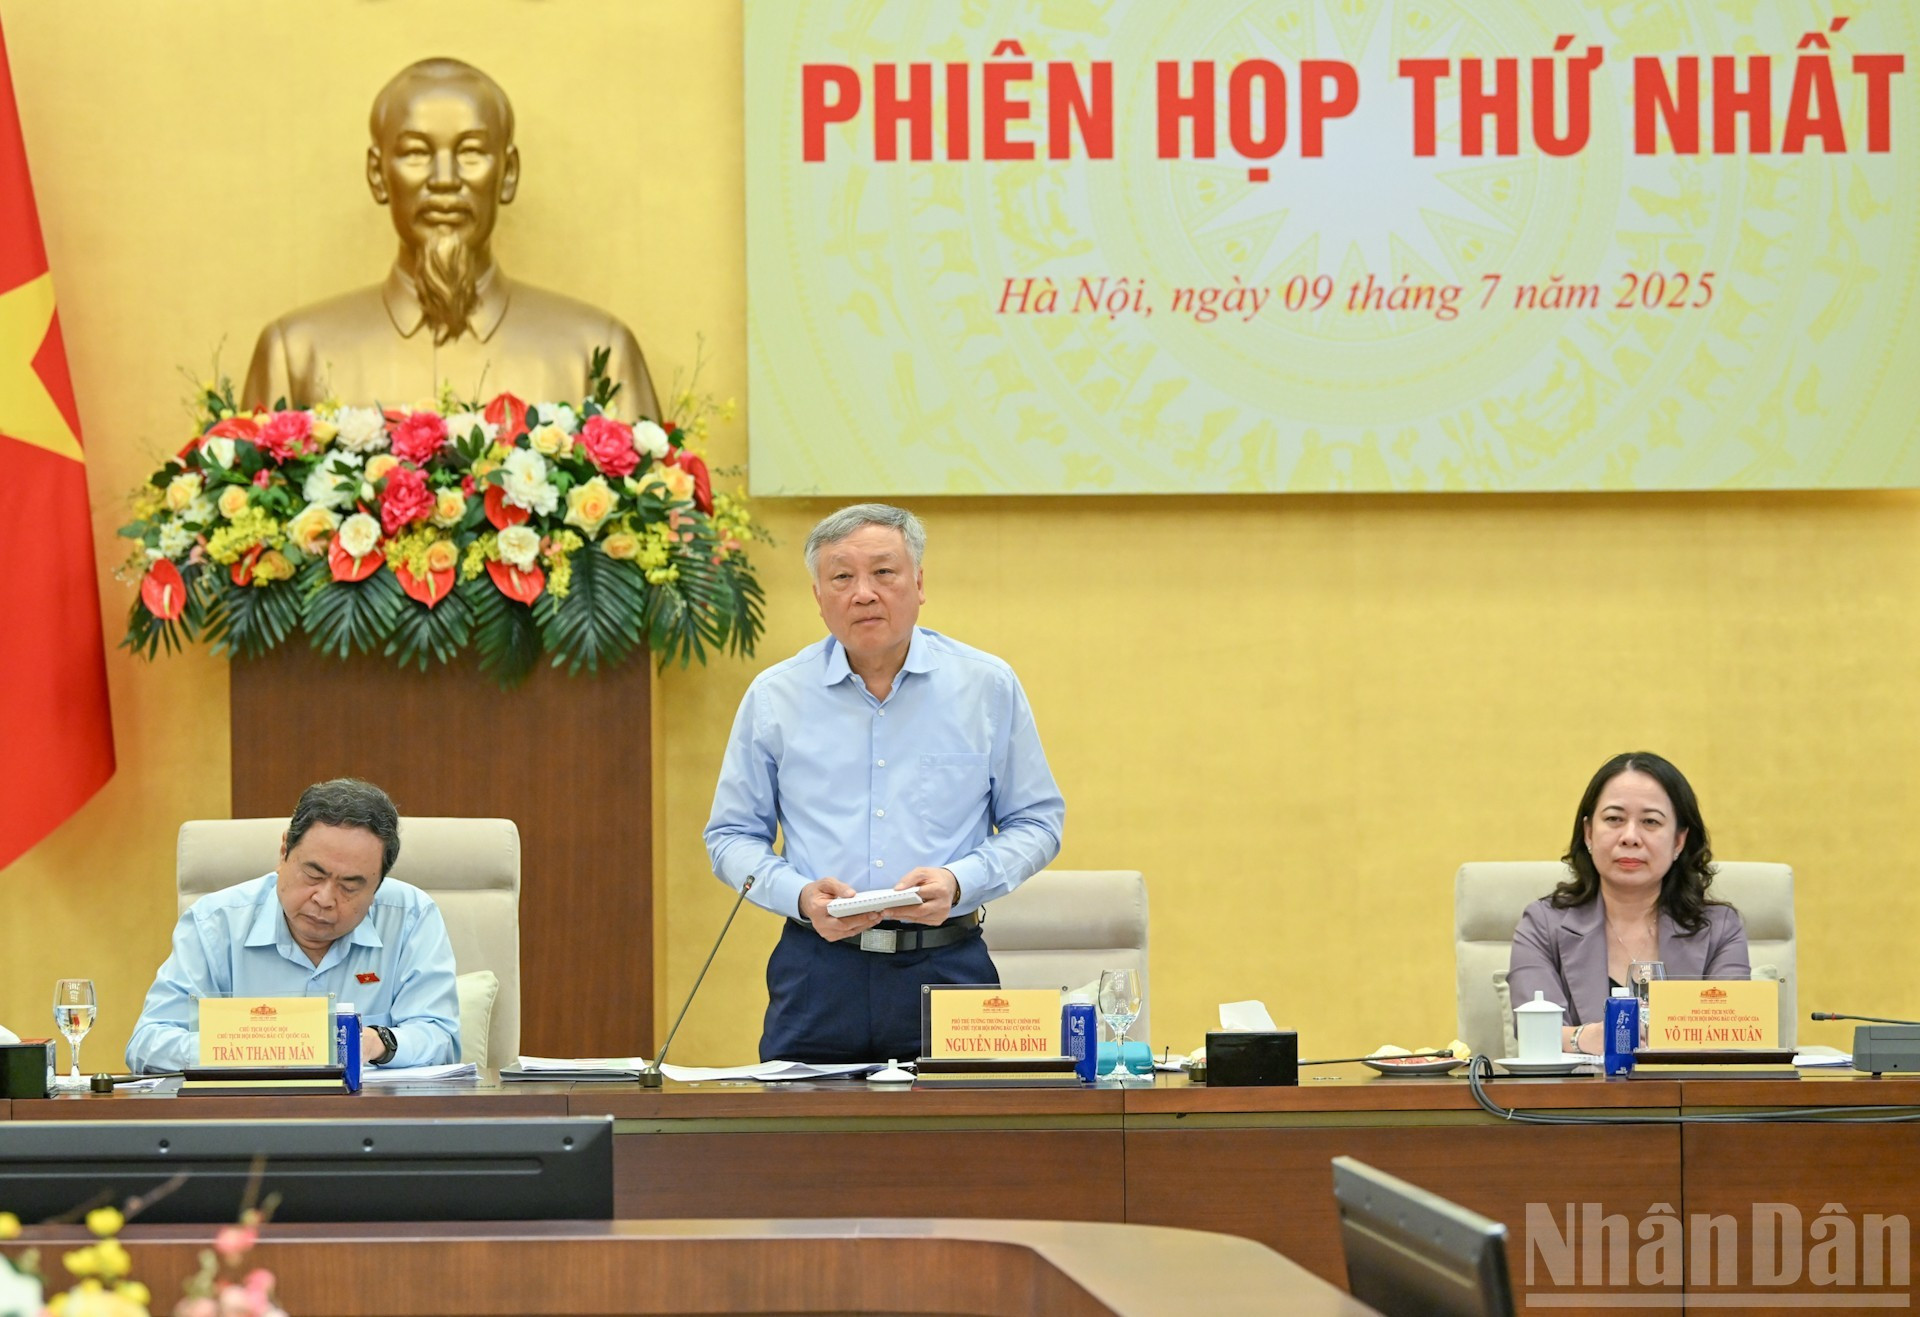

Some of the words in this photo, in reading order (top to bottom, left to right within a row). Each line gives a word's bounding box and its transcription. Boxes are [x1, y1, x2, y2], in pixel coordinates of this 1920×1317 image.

[801, 40, 1115, 163] PHIÊN
[1156, 59, 1361, 182] HỌP
[1397, 34, 1604, 158] THỨ
[1633, 17, 1905, 156] NHẤT
[997, 276, 1058, 314] Hà
[1070, 274, 1154, 319] Nội,
[1171, 276, 1271, 322] ngày
[1283, 275, 1334, 312] 09
[1346, 275, 1462, 320] tháng
[1481, 275, 1501, 309] 7
[1512, 276, 1601, 310] năm
[1615, 272, 1716, 309] 2025
[994, 1034, 1018, 1052] HÒA
[1020, 1034, 1047, 1052] BÌNH
[1665, 1025, 1681, 1041] VÕ
[1683, 1028, 1703, 1044] THỊ
[1705, 1025, 1729, 1041] ÁNH
[1731, 1025, 1763, 1041] XUÂN
[246, 1046, 286, 1061] THANH
